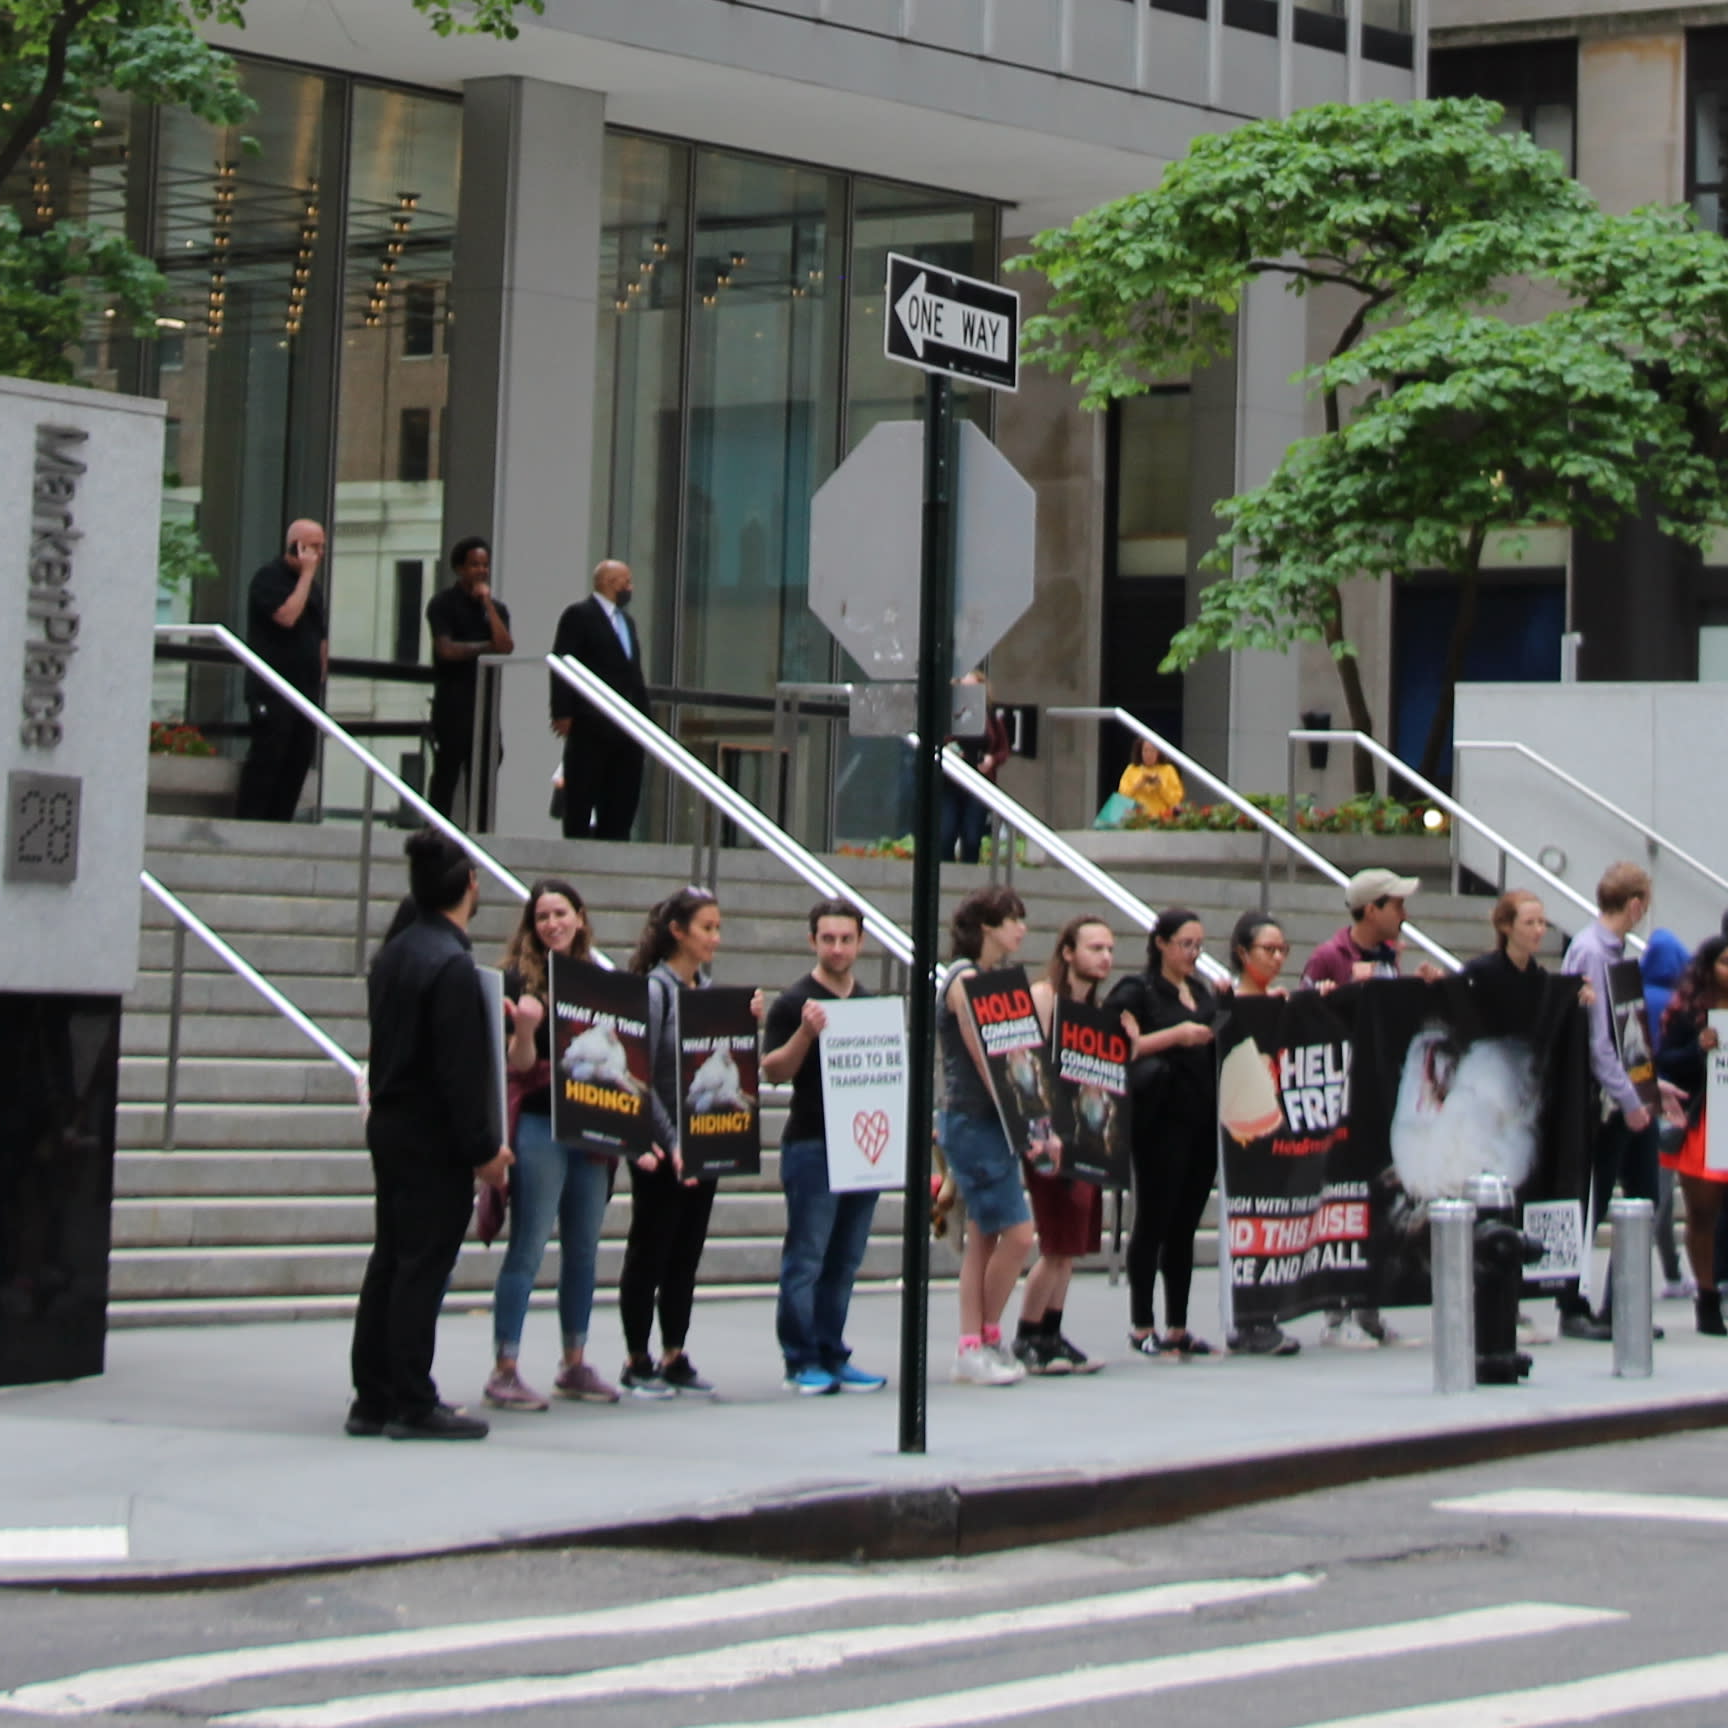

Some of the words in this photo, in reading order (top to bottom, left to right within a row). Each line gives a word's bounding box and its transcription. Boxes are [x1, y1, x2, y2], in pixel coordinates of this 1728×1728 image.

[908, 294, 943, 339] ONE
[962, 309, 1000, 353] WAY
[18, 789, 72, 865] 28
[556, 1001, 592, 1023] WHAT
[616, 1018, 646, 1037] THEY
[973, 989, 1033, 1025] HOLD
[682, 1037, 712, 1052] WHAT
[732, 1035, 756, 1050] THEY
[826, 1033, 900, 1048] CORPORATIONS
[981, 1016, 1038, 1039] COMPANIES
[1062, 1021, 1128, 1063] HOLD
[828, 1053, 862, 1069] NEED
[866, 1052, 883, 1068] TO
[886, 1051, 903, 1066] BE
[1060, 1047, 1126, 1079] COMPANIES
[830, 1071, 903, 1088] TRANSPARENT
[565, 1079, 641, 1115] HIDING?
[690, 1112, 752, 1136] HIDING?
[1255, 1196, 1290, 1214] WITH
[1261, 1217, 1309, 1251] THIS
[1259, 1256, 1301, 1285] AND
[1321, 1241, 1368, 1270] ALL
